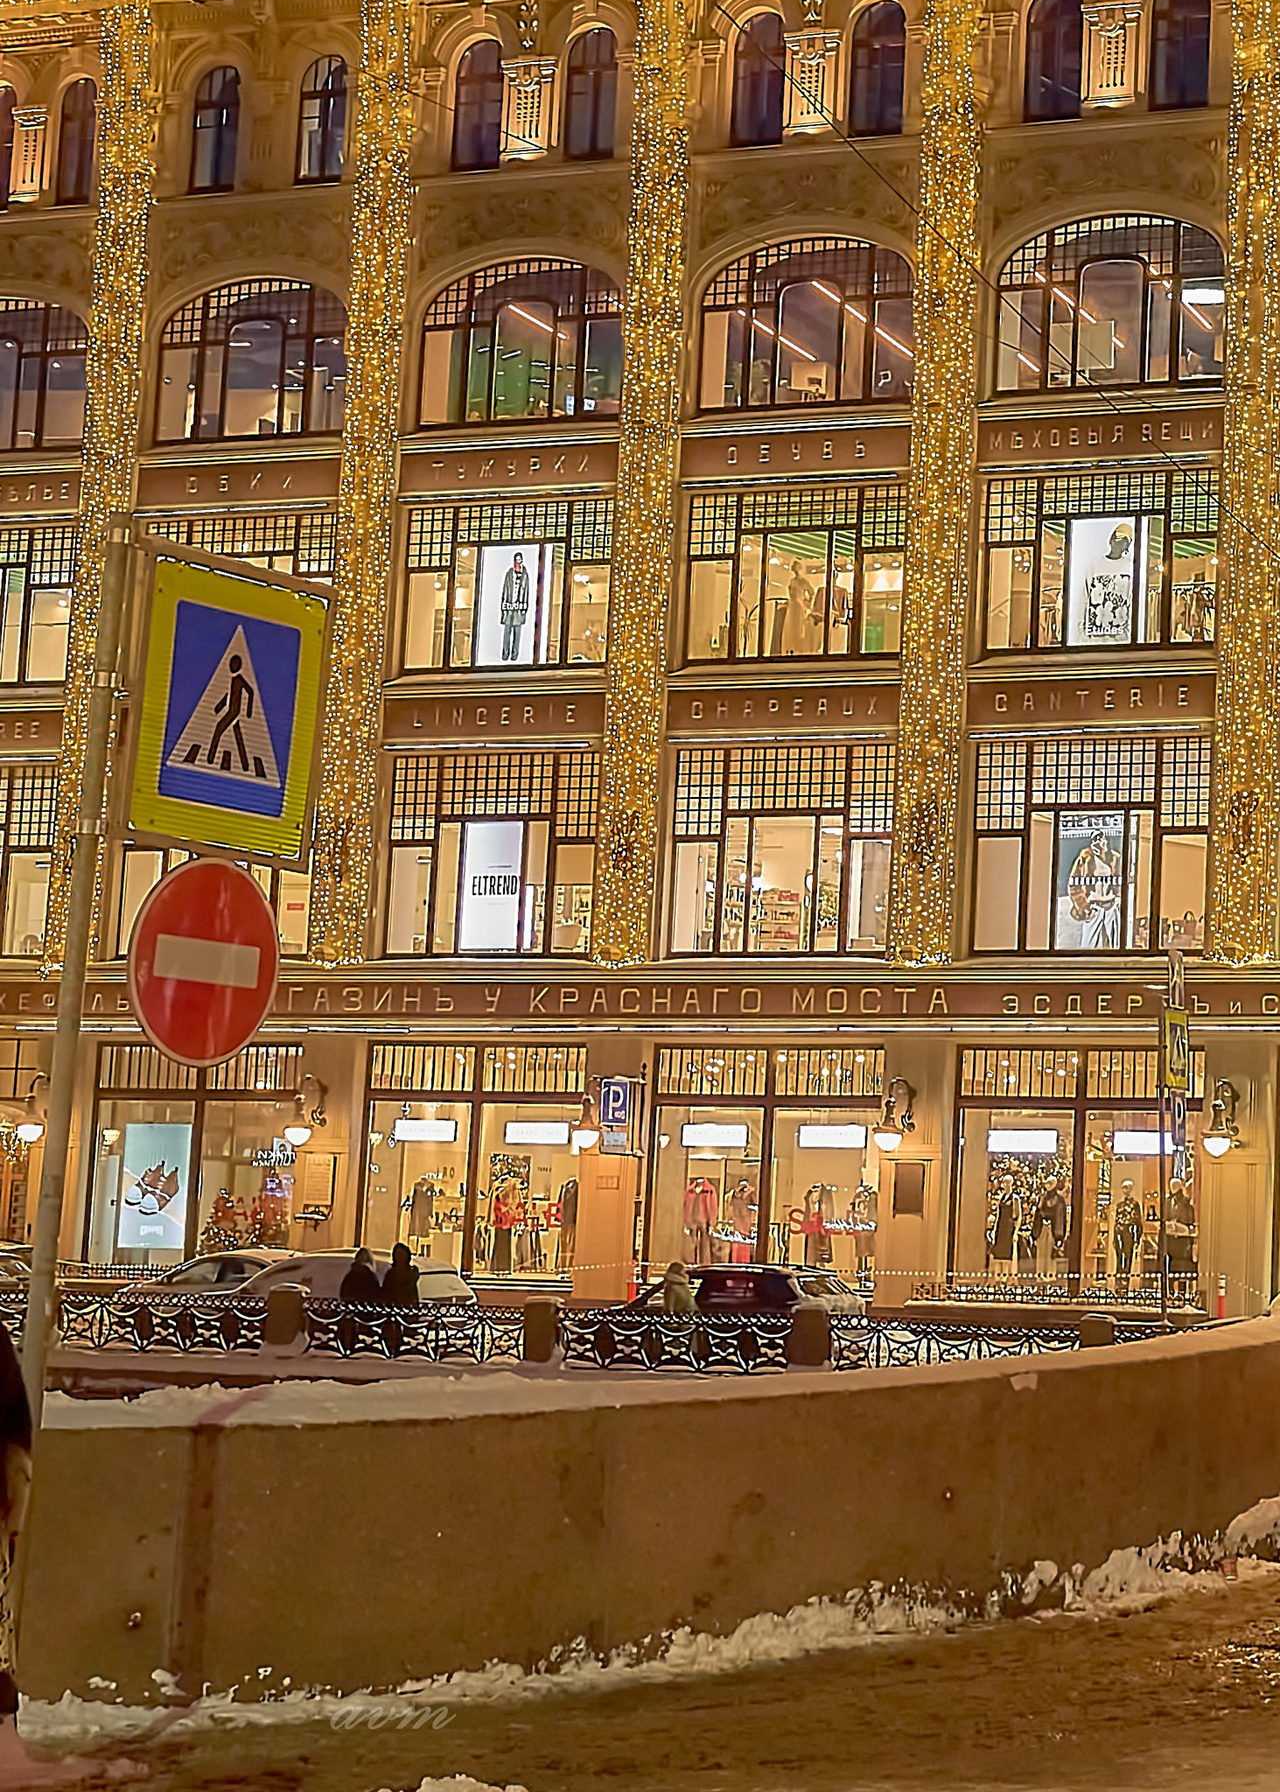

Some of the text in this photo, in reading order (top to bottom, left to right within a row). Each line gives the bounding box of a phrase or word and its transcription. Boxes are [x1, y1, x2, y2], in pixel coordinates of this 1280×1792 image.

[1142, 419, 1213, 442] ВЕЩИ
[692, 695, 877, 720] CHAPEAUX
[471, 874, 519, 896] ELTREND
[274, 987, 454, 1012] ГАЗИНЪ
[484, 986, 501, 1013] У
[528, 987, 762, 1014] КРАСНАГО
[792, 987, 949, 1014] МОСТА
[1002, 994, 1210, 1016] ЭСДЕРЪ
[608, 1085, 624, 1120] P
